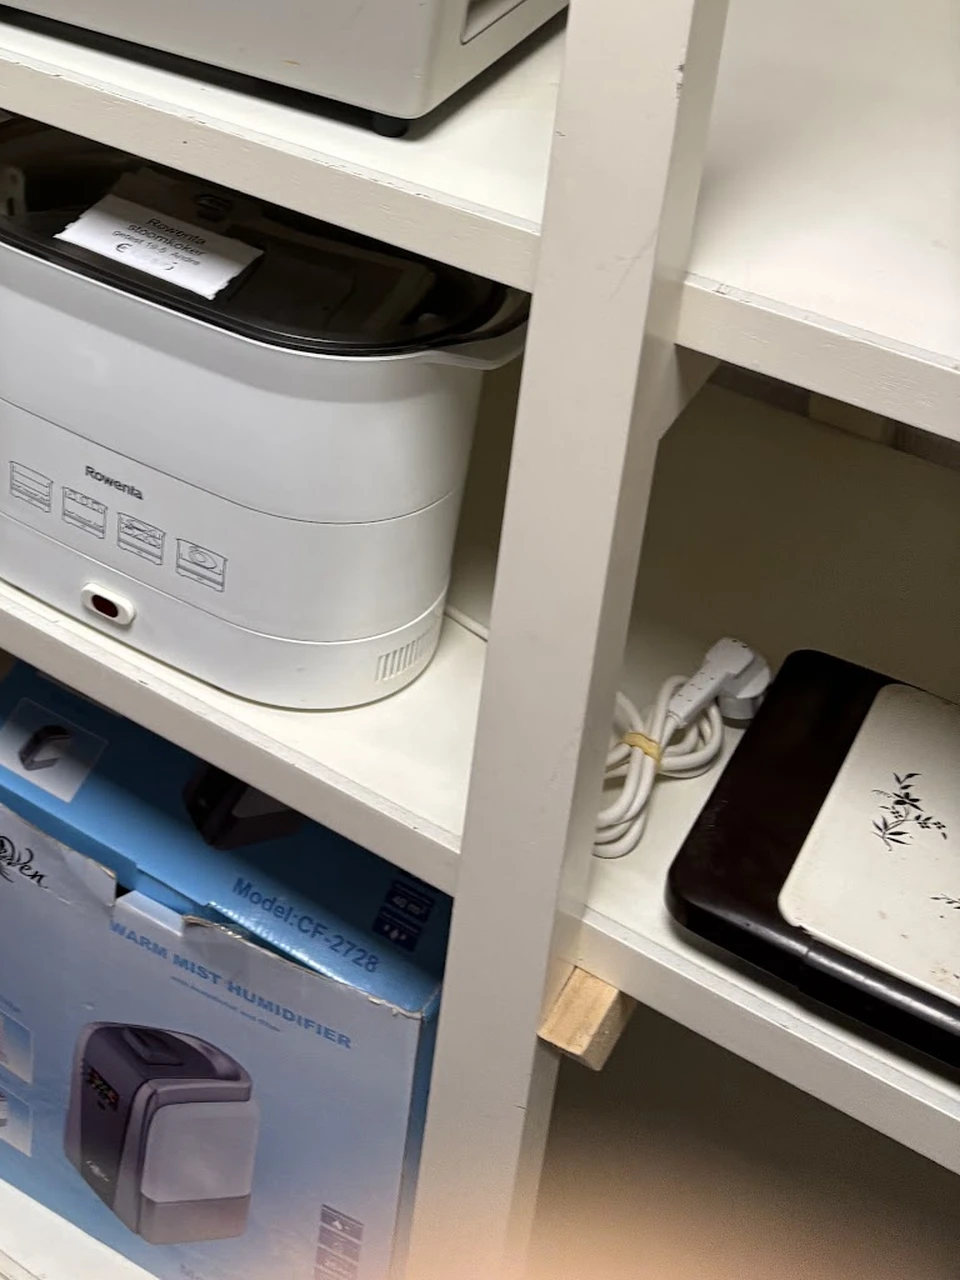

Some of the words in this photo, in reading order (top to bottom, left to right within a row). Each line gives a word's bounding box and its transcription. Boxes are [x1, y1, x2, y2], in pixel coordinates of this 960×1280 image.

[126, 223, 207, 257] stoomkoker
[146, 218, 207, 246] Rowenta
[84, 464, 145, 501] Rowenta
[232, 876, 380, 974] Model:CF-2728
[108, 920, 169, 960] WARM
[171, 953, 223, 986] MIST
[226, 979, 353, 1050] HUMIDIFIER
